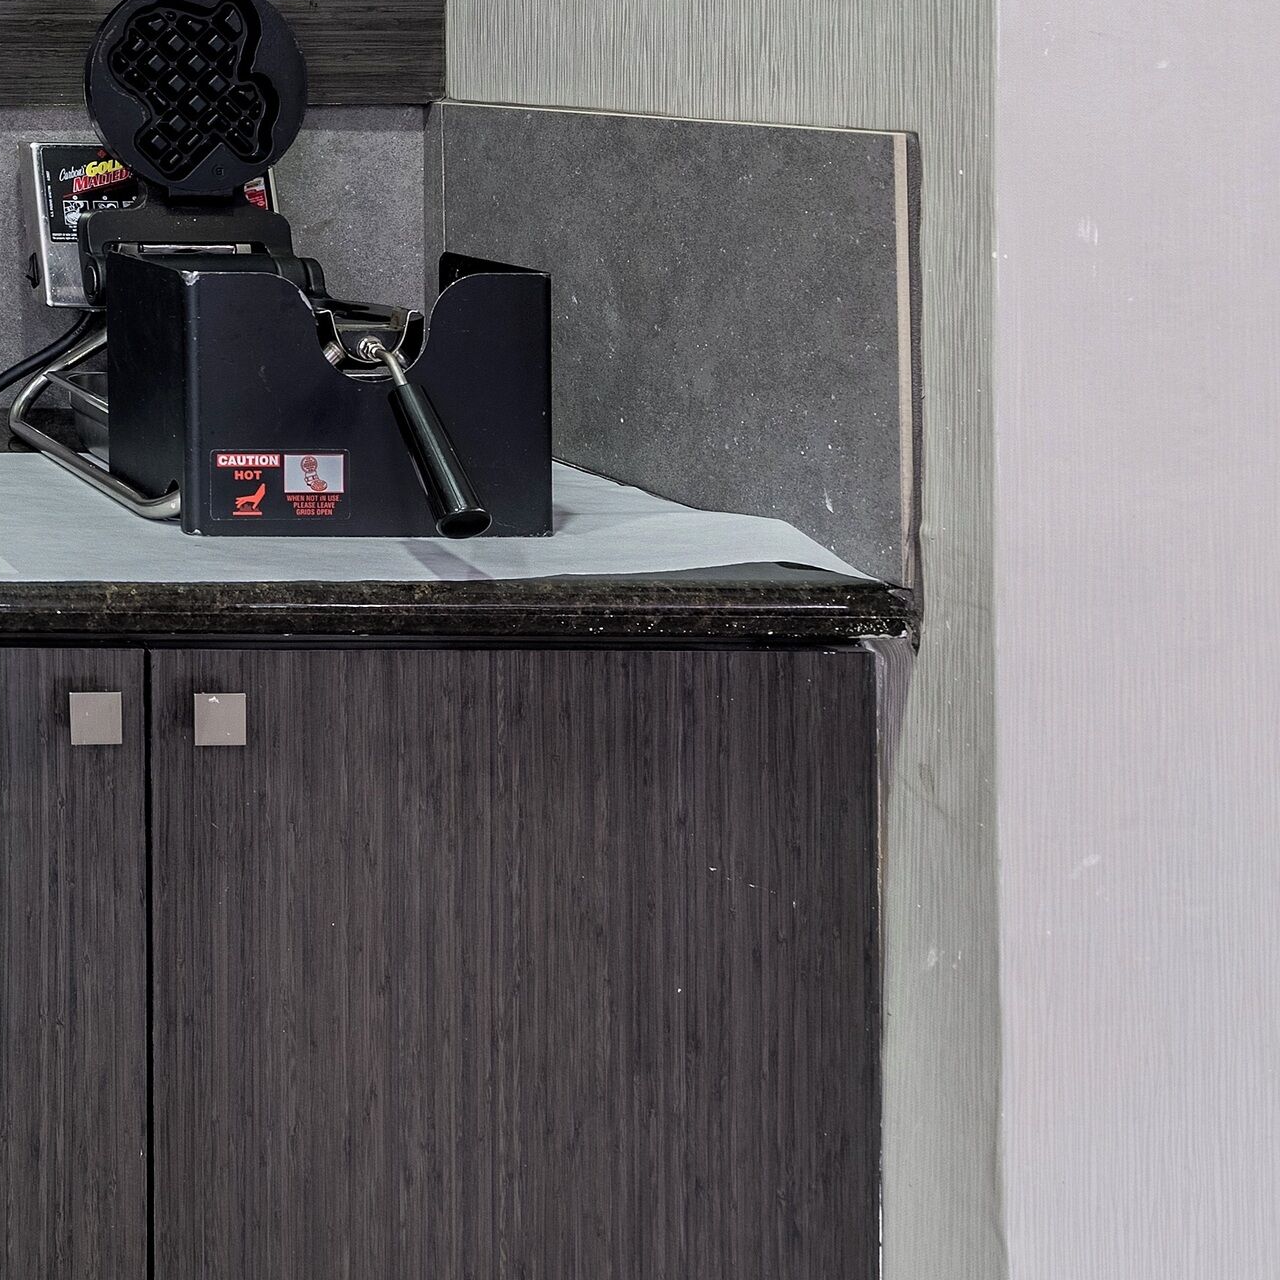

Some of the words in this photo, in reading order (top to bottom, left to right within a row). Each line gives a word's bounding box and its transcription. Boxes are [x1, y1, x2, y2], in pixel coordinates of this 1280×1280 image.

[73, 168, 130, 193] MALTED
[218, 454, 280, 466] CAUTION
[234, 470, 262, 480] HOT
[287, 494, 305, 502] WHEN
[306, 494, 318, 502] NOT
[320, 494, 327, 502] IN
[293, 501, 316, 509] PLEASE
[316, 501, 335, 509] LEAVE
